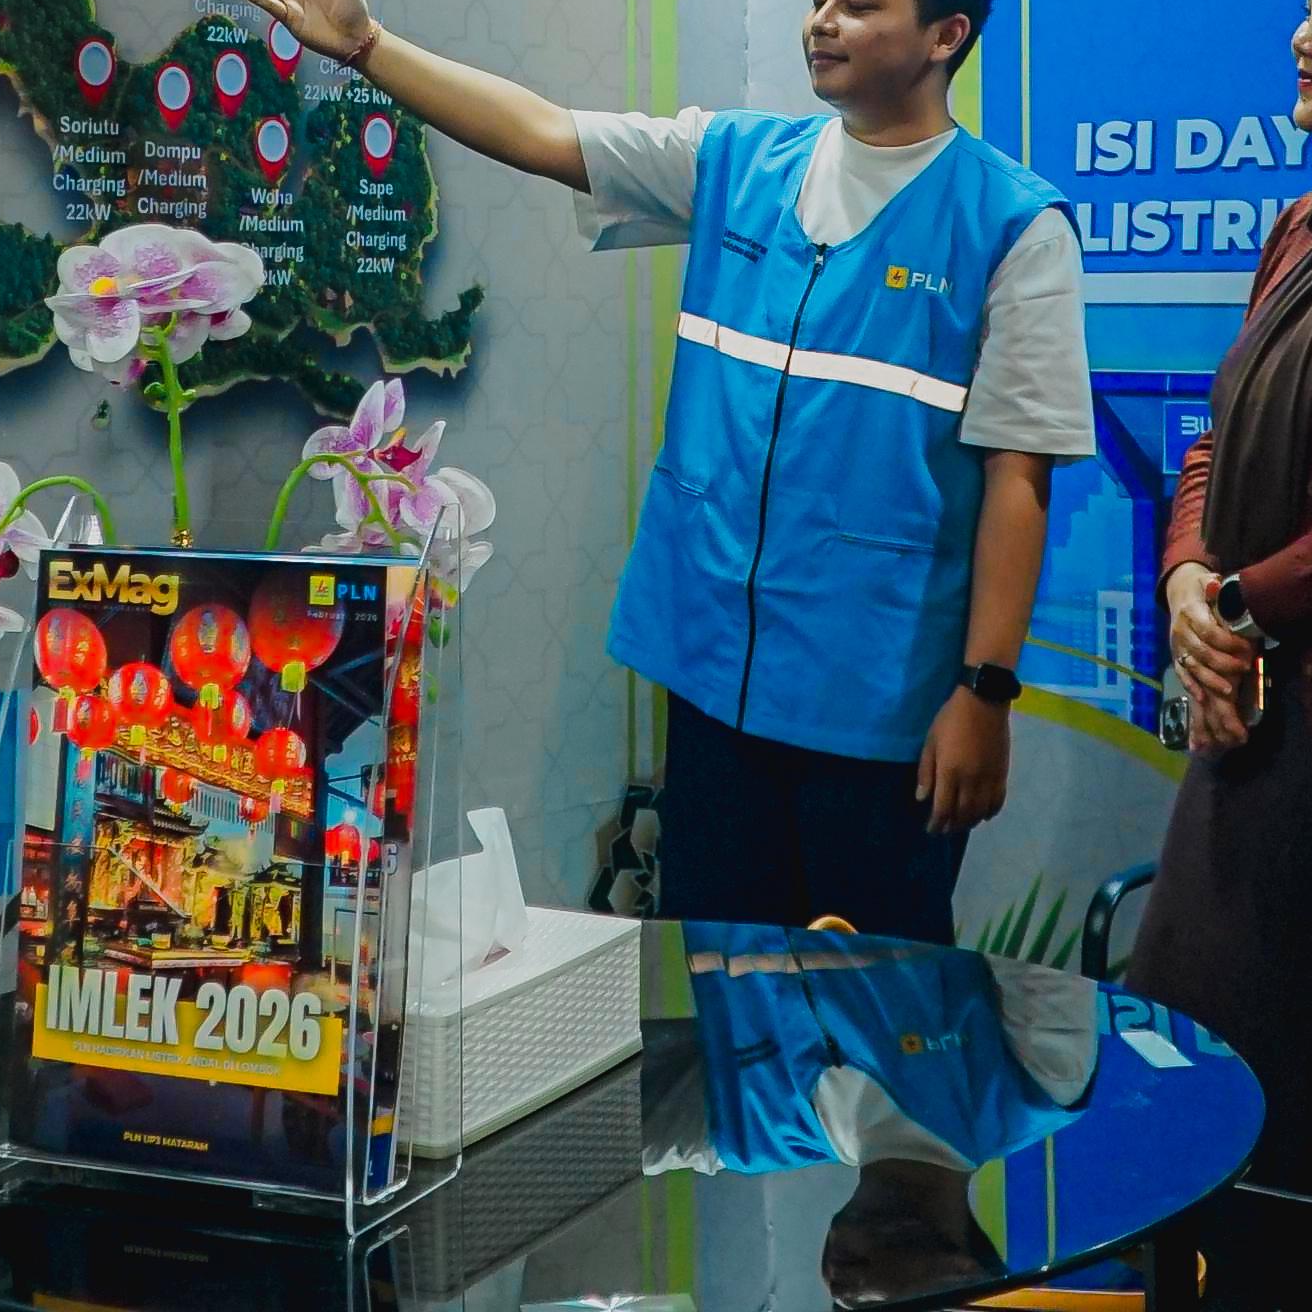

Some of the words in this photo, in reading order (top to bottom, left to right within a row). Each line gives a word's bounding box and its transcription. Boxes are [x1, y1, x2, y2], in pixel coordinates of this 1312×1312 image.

[207, 26, 248, 44] 22kW
[304, 85, 343, 101] 22kW
[53, 145, 126, 164] /Medium
[145, 141, 201, 162] Dompu
[1076, 119, 1153, 173] ISI
[53, 174, 126, 196] Charging
[138, 171, 207, 189] /Medium
[359, 179, 394, 198] Sape
[65, 204, 111, 220] 22kW
[138, 197, 207, 219] Charging
[346, 205, 407, 222] /Medium
[240, 215, 304, 233] /Medium
[1076, 198, 1296, 252] LISTRI
[346, 231, 407, 251] Charging
[241, 241, 304, 263] harging
[357, 257, 395, 274] 22kW
[47, 560, 180, 615] ExMag
[336, 582, 378, 602] PLN
[45, 964, 183, 1046] IMLEK
[194, 981, 322, 1062] 2026
